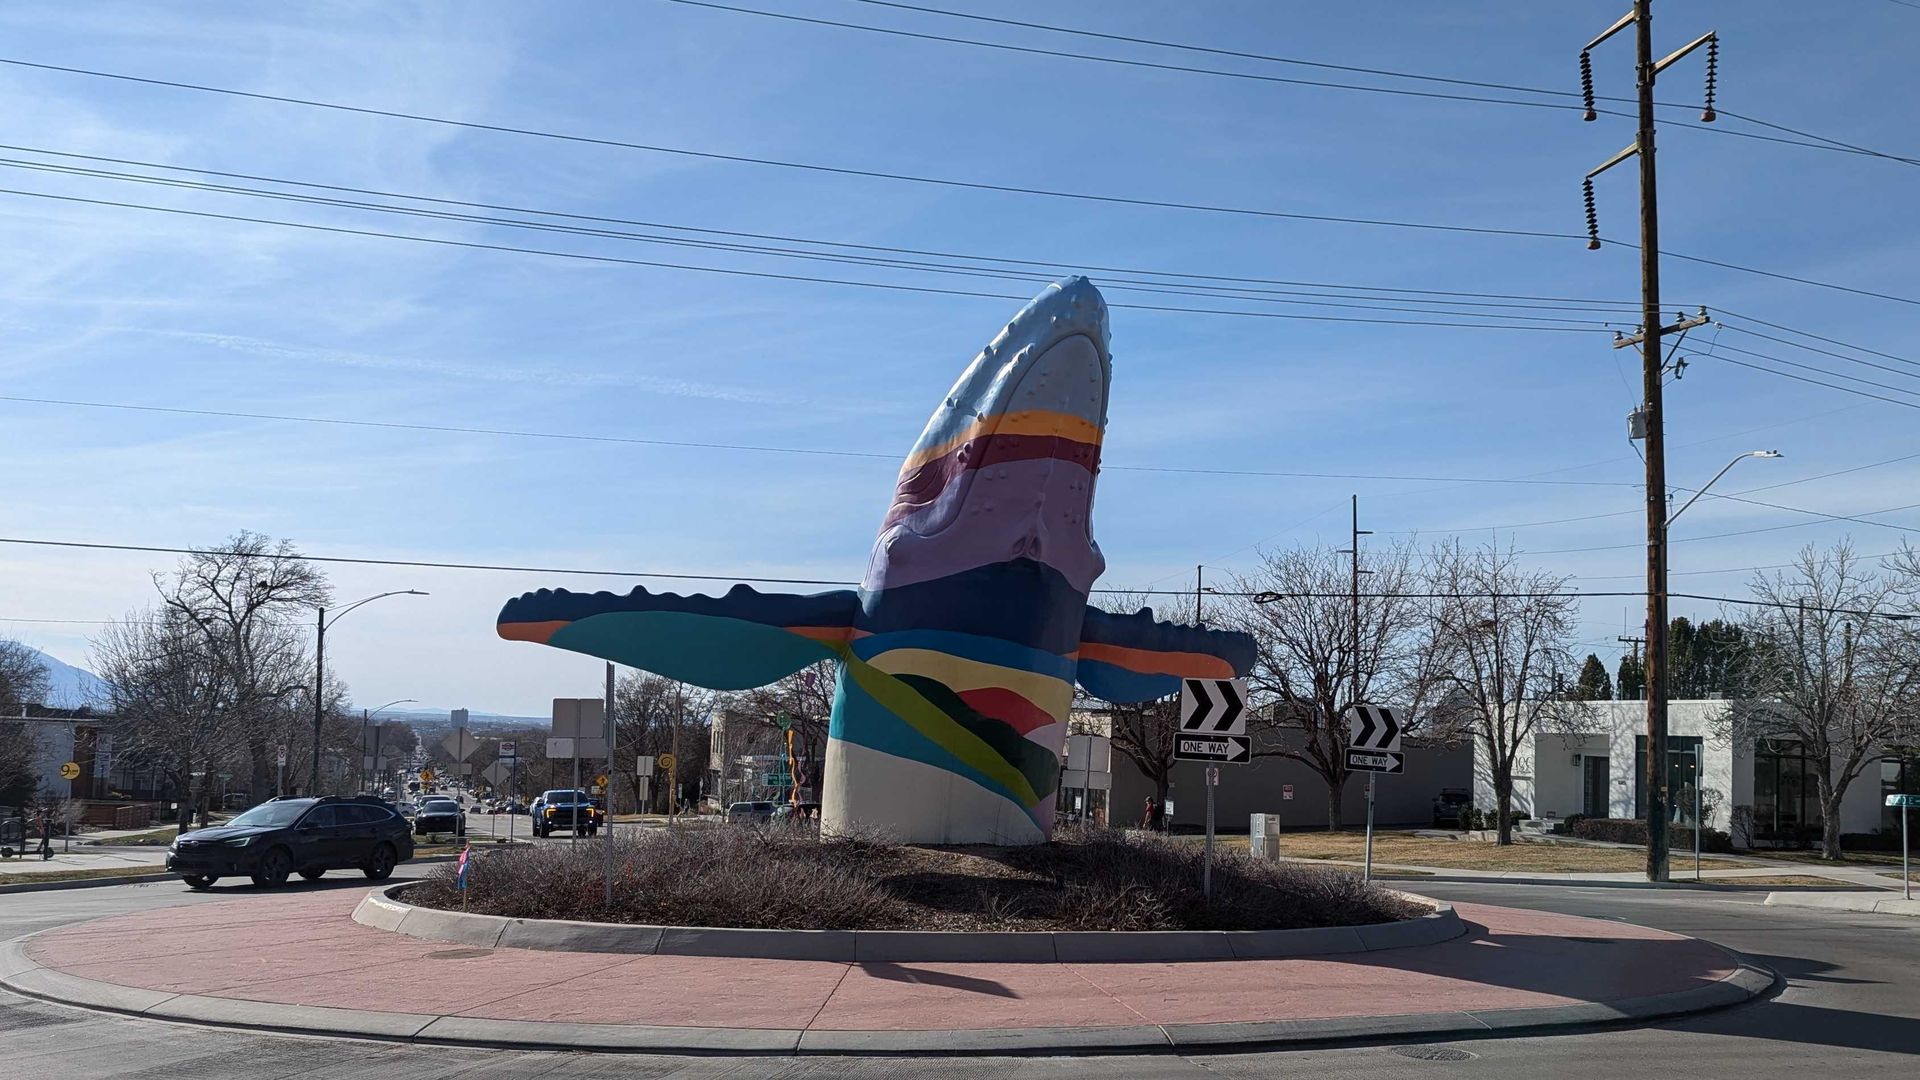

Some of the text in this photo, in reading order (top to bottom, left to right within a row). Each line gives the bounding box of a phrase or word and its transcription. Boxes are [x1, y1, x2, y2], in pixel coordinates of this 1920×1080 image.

[1183, 741, 1229, 754] ONE WAY
[1352, 755, 1388, 767] ONE WAY
[60, 764, 70, 776] 9
